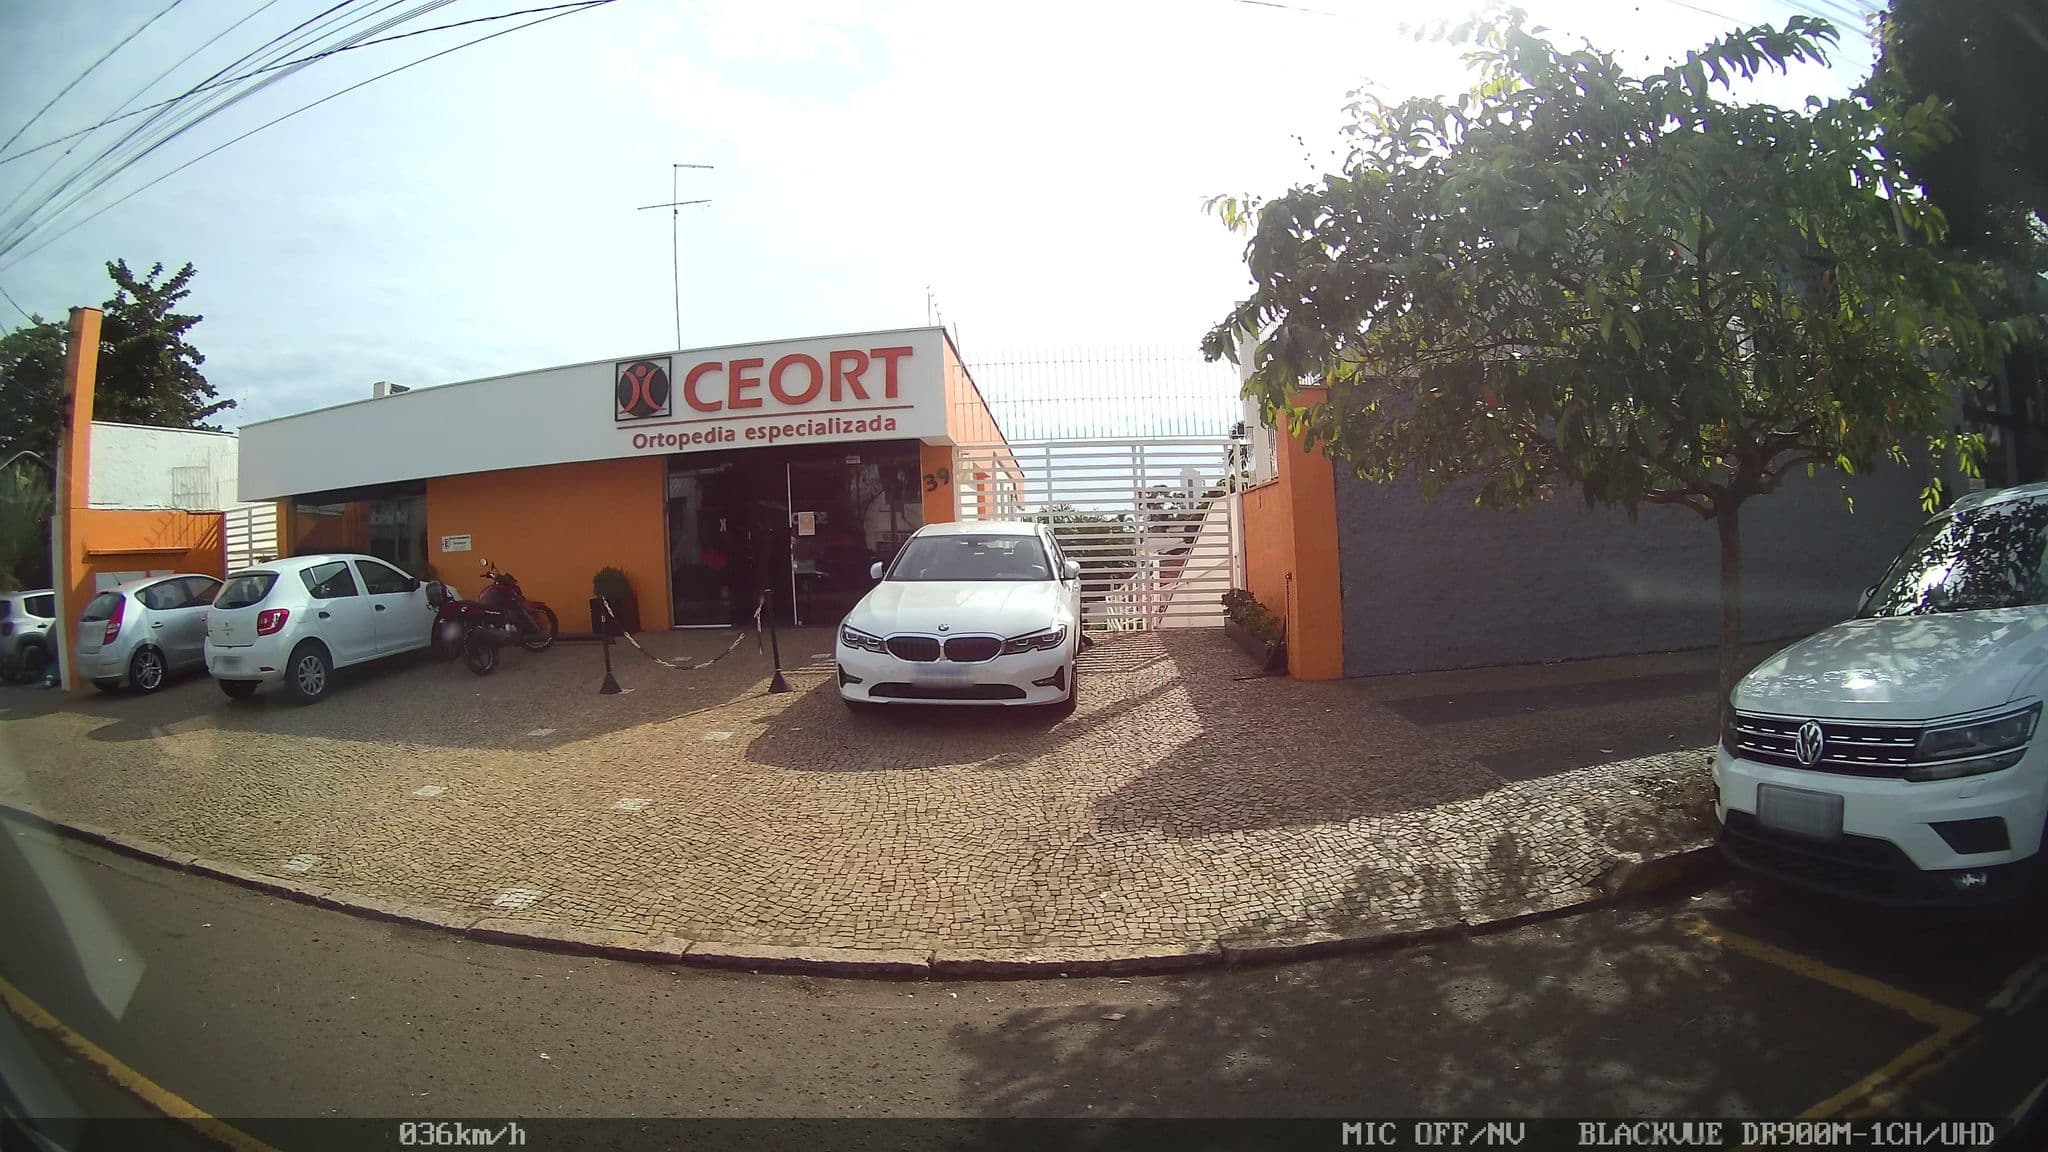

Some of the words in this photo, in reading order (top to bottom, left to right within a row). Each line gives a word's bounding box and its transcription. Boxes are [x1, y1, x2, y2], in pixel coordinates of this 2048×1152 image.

[684, 346, 913, 412] CEORT
[632, 426, 736, 450] Ortopedia
[745, 415, 897, 442] especializada
[924, 467, 950, 492] 39
